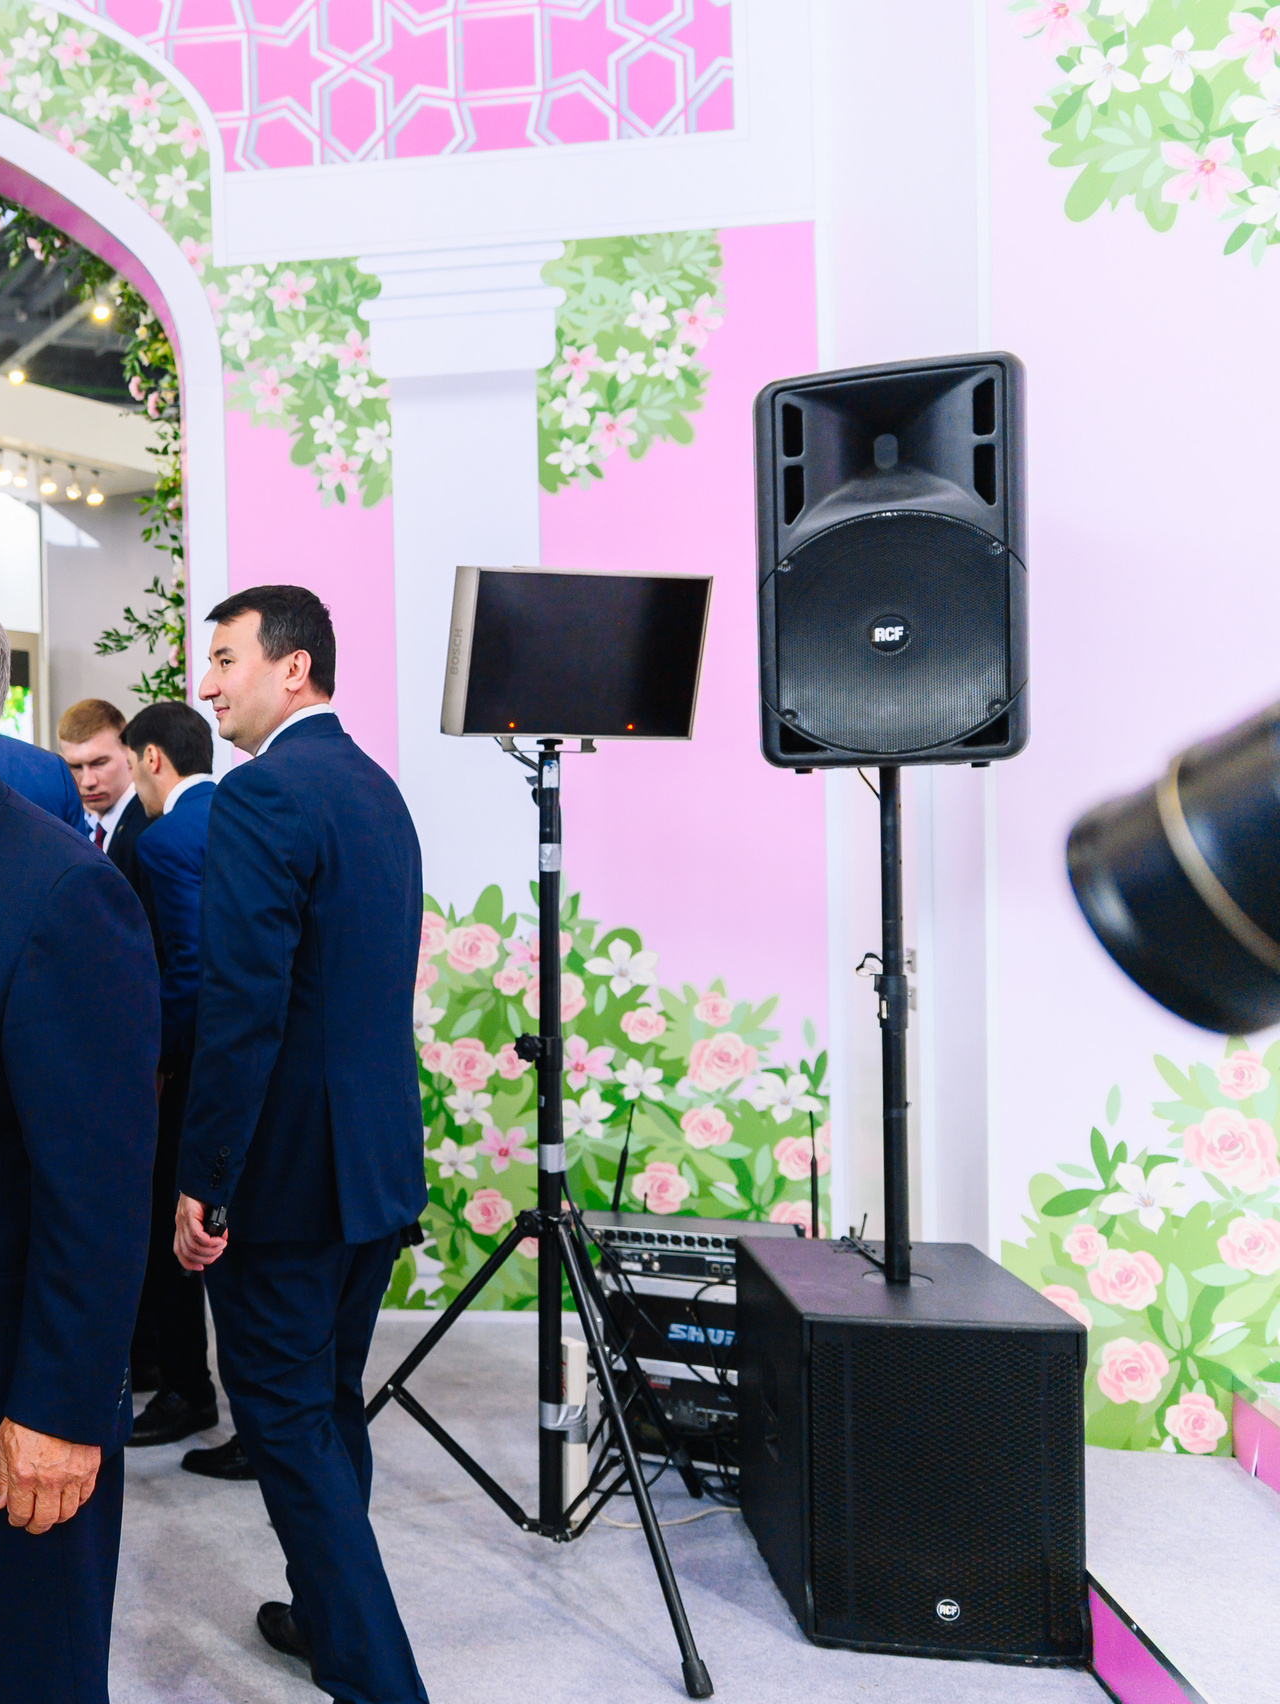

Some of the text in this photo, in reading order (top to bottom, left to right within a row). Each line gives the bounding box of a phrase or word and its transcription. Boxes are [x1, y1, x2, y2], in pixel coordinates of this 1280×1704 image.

[874, 625, 904, 642] RCF
[450, 628, 463, 675] BOSCH
[939, 1604, 958, 1616] RCF
